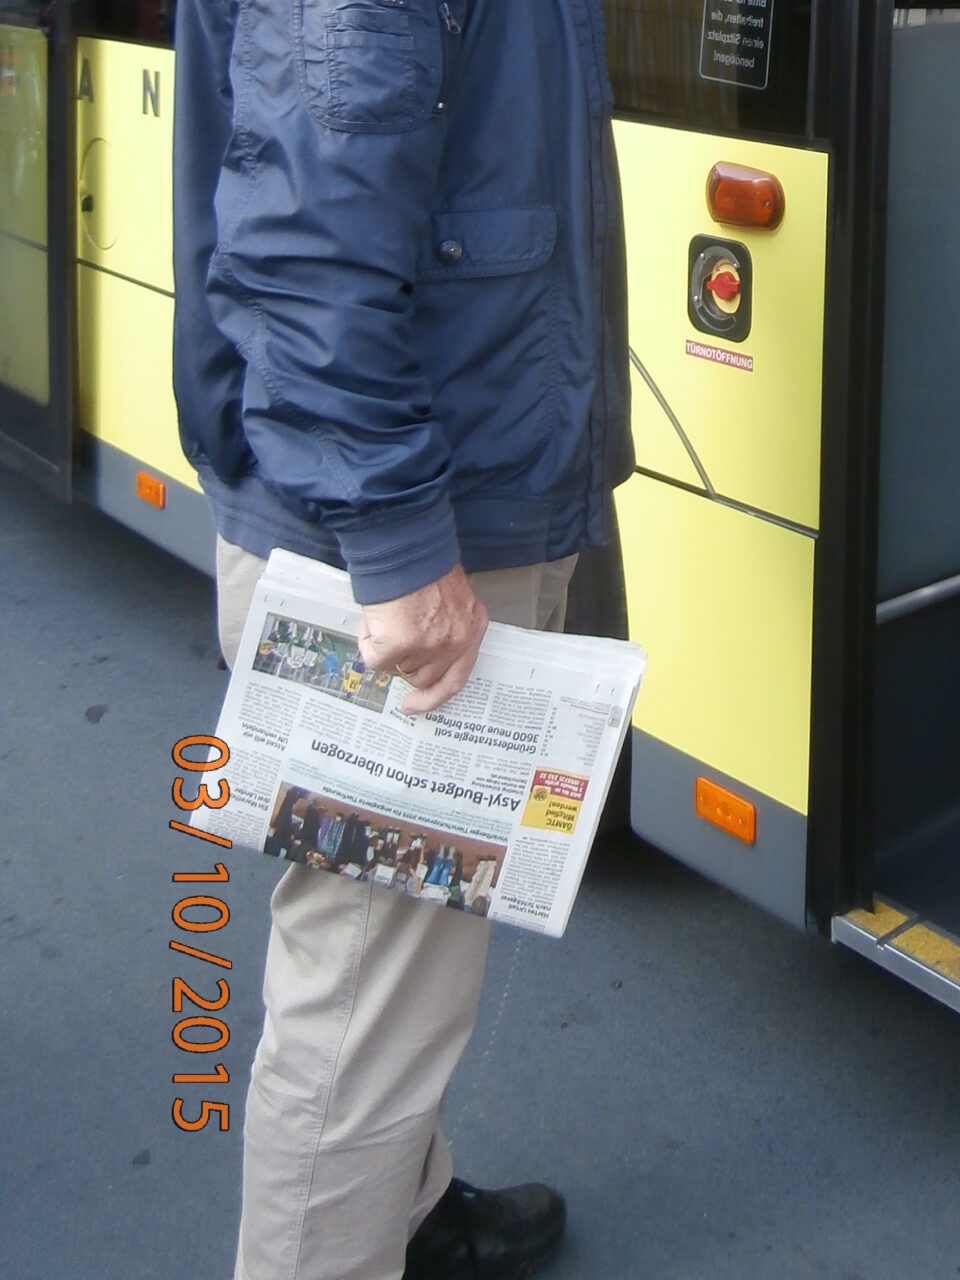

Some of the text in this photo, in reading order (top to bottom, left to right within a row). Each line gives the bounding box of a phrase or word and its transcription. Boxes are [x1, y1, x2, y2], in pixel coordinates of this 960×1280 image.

[686, 342, 753, 369] TÜRNOTÖFFNUNG
[463, 721, 486, 733] Jobs
[487, 726, 511, 737] neue
[512, 731, 539, 743] 3600
[434, 727, 536, 754] Gründerstrategie soll
[311, 739, 384, 777] überzogen
[386, 767, 428, 789] schon
[430, 781, 521, 811] Asyl-Budget
